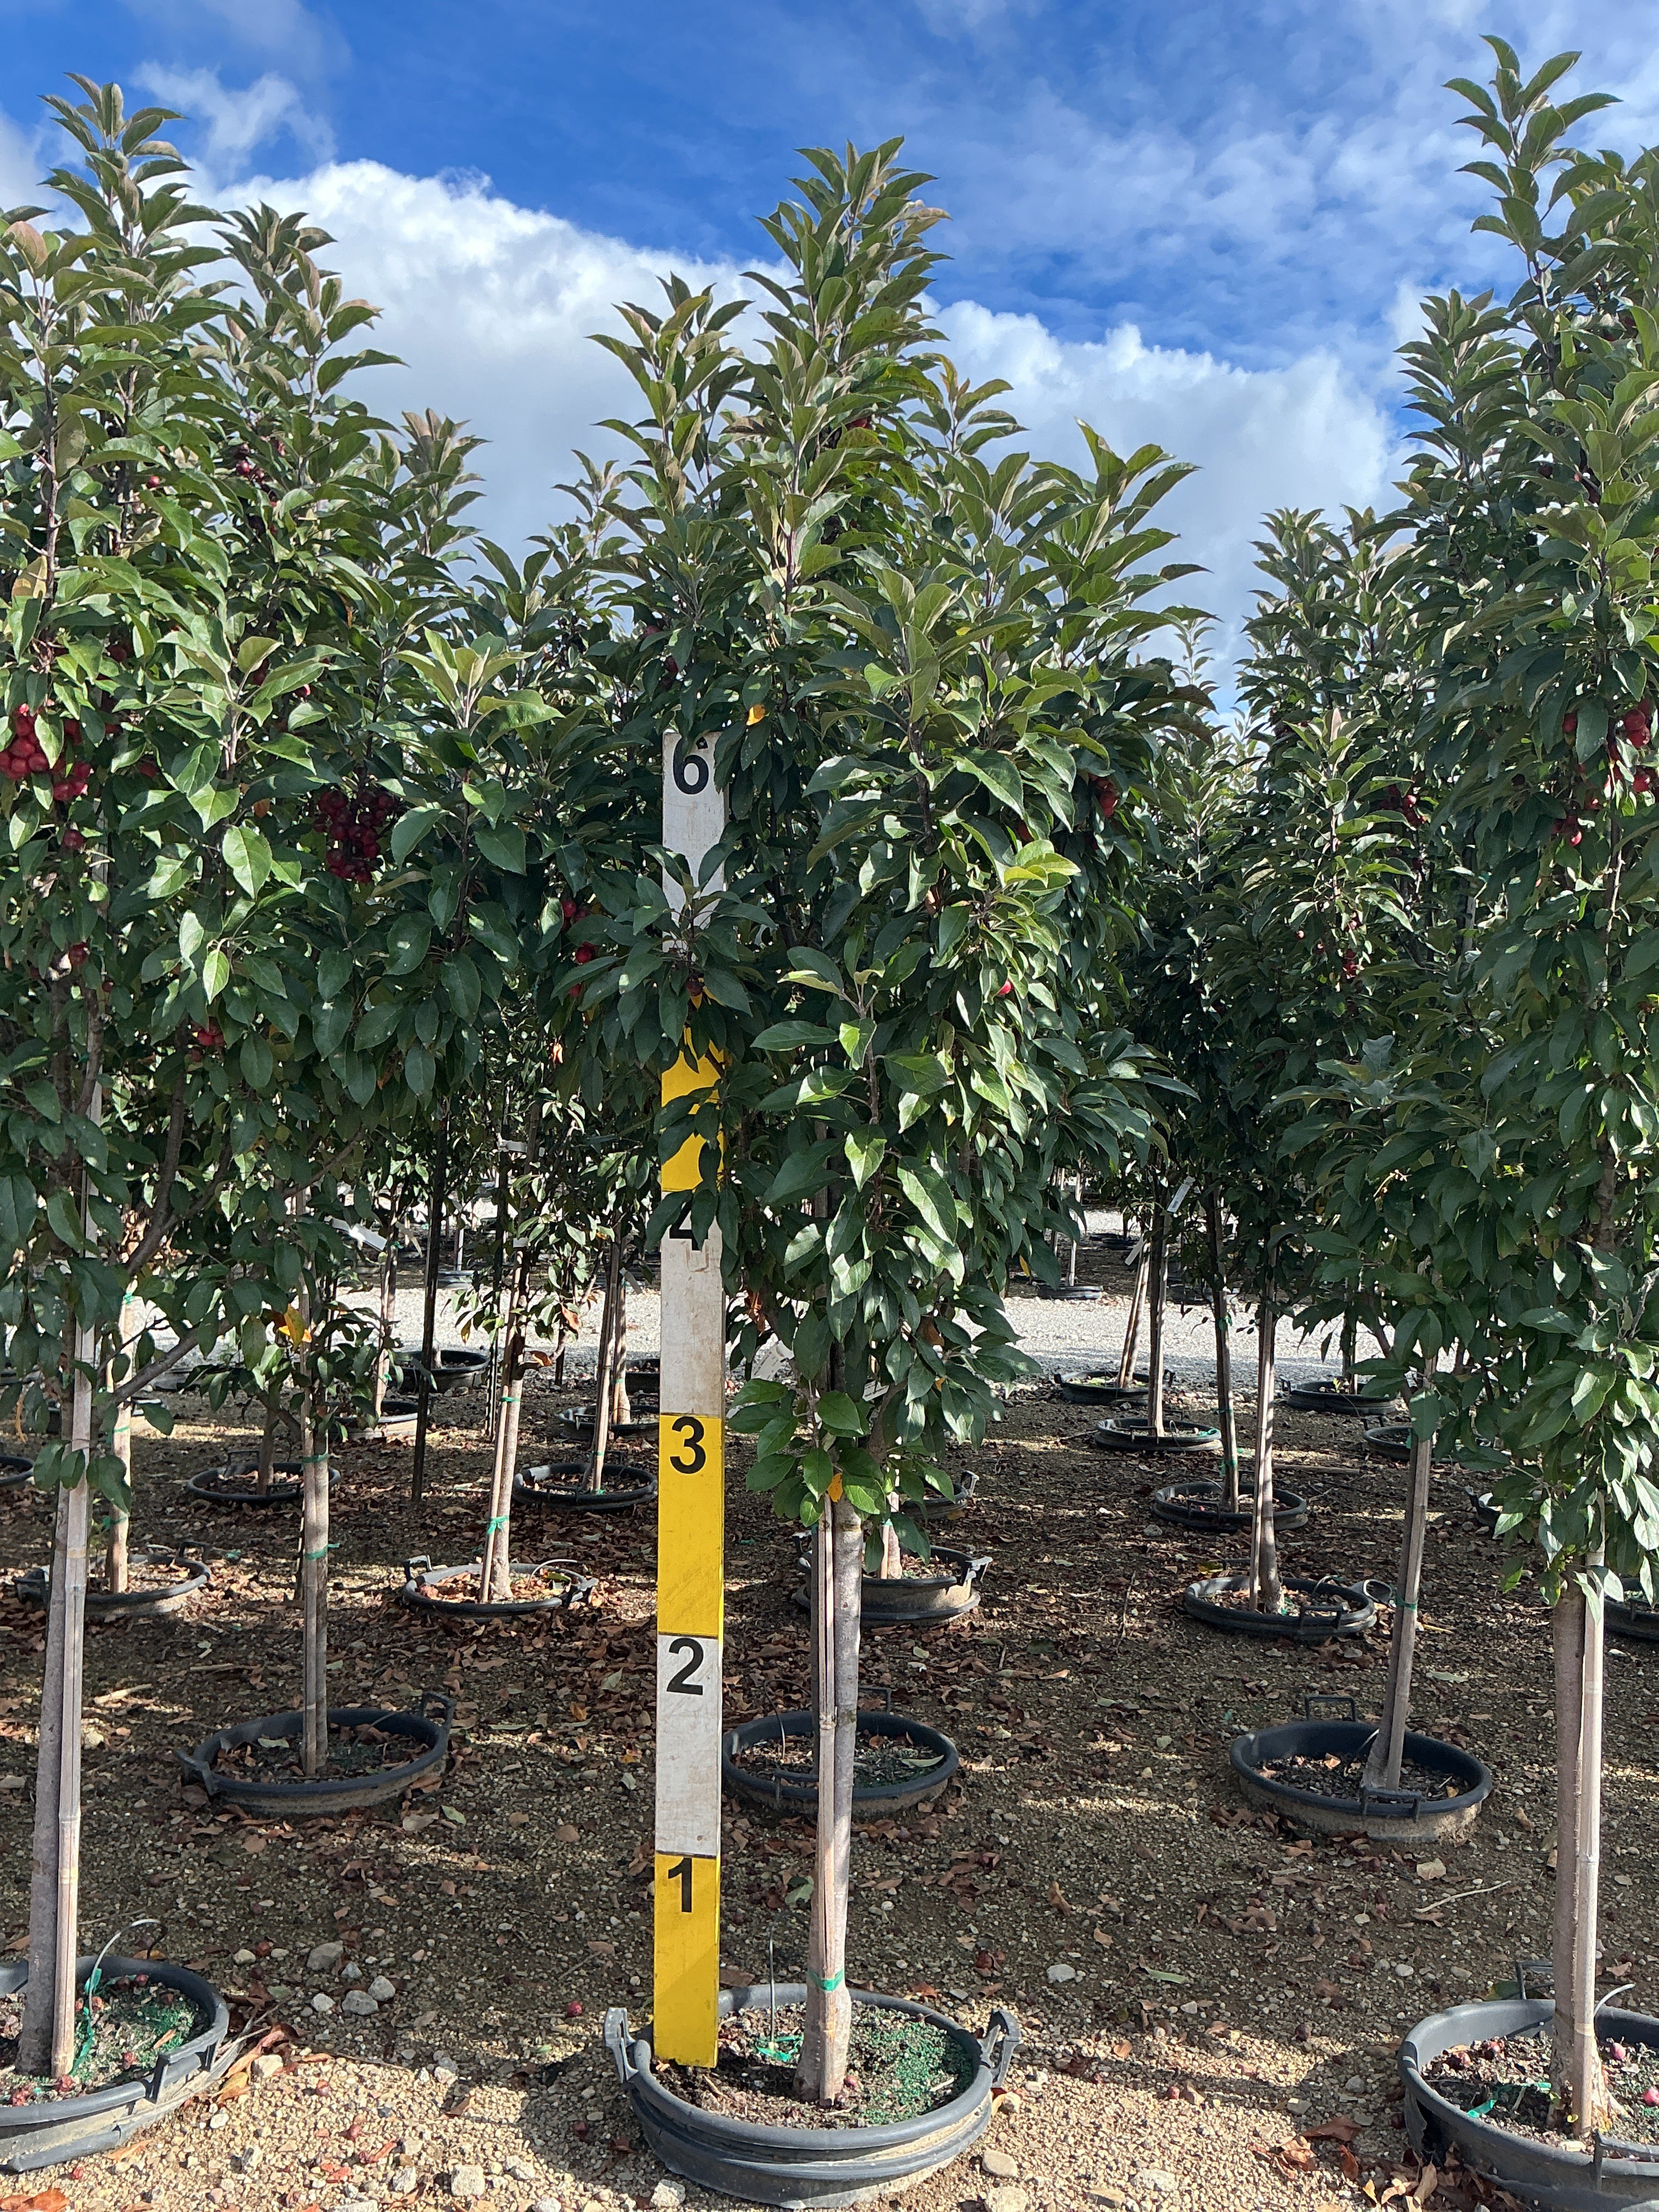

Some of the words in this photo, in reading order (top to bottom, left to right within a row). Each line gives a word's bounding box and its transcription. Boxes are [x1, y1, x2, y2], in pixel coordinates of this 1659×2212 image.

[673, 737, 709, 794] 6
[669, 1200, 709, 1251] 4
[669, 1416, 706, 1474] 3
[666, 1637, 704, 1695] 2
[668, 1857, 693, 1912] 1
